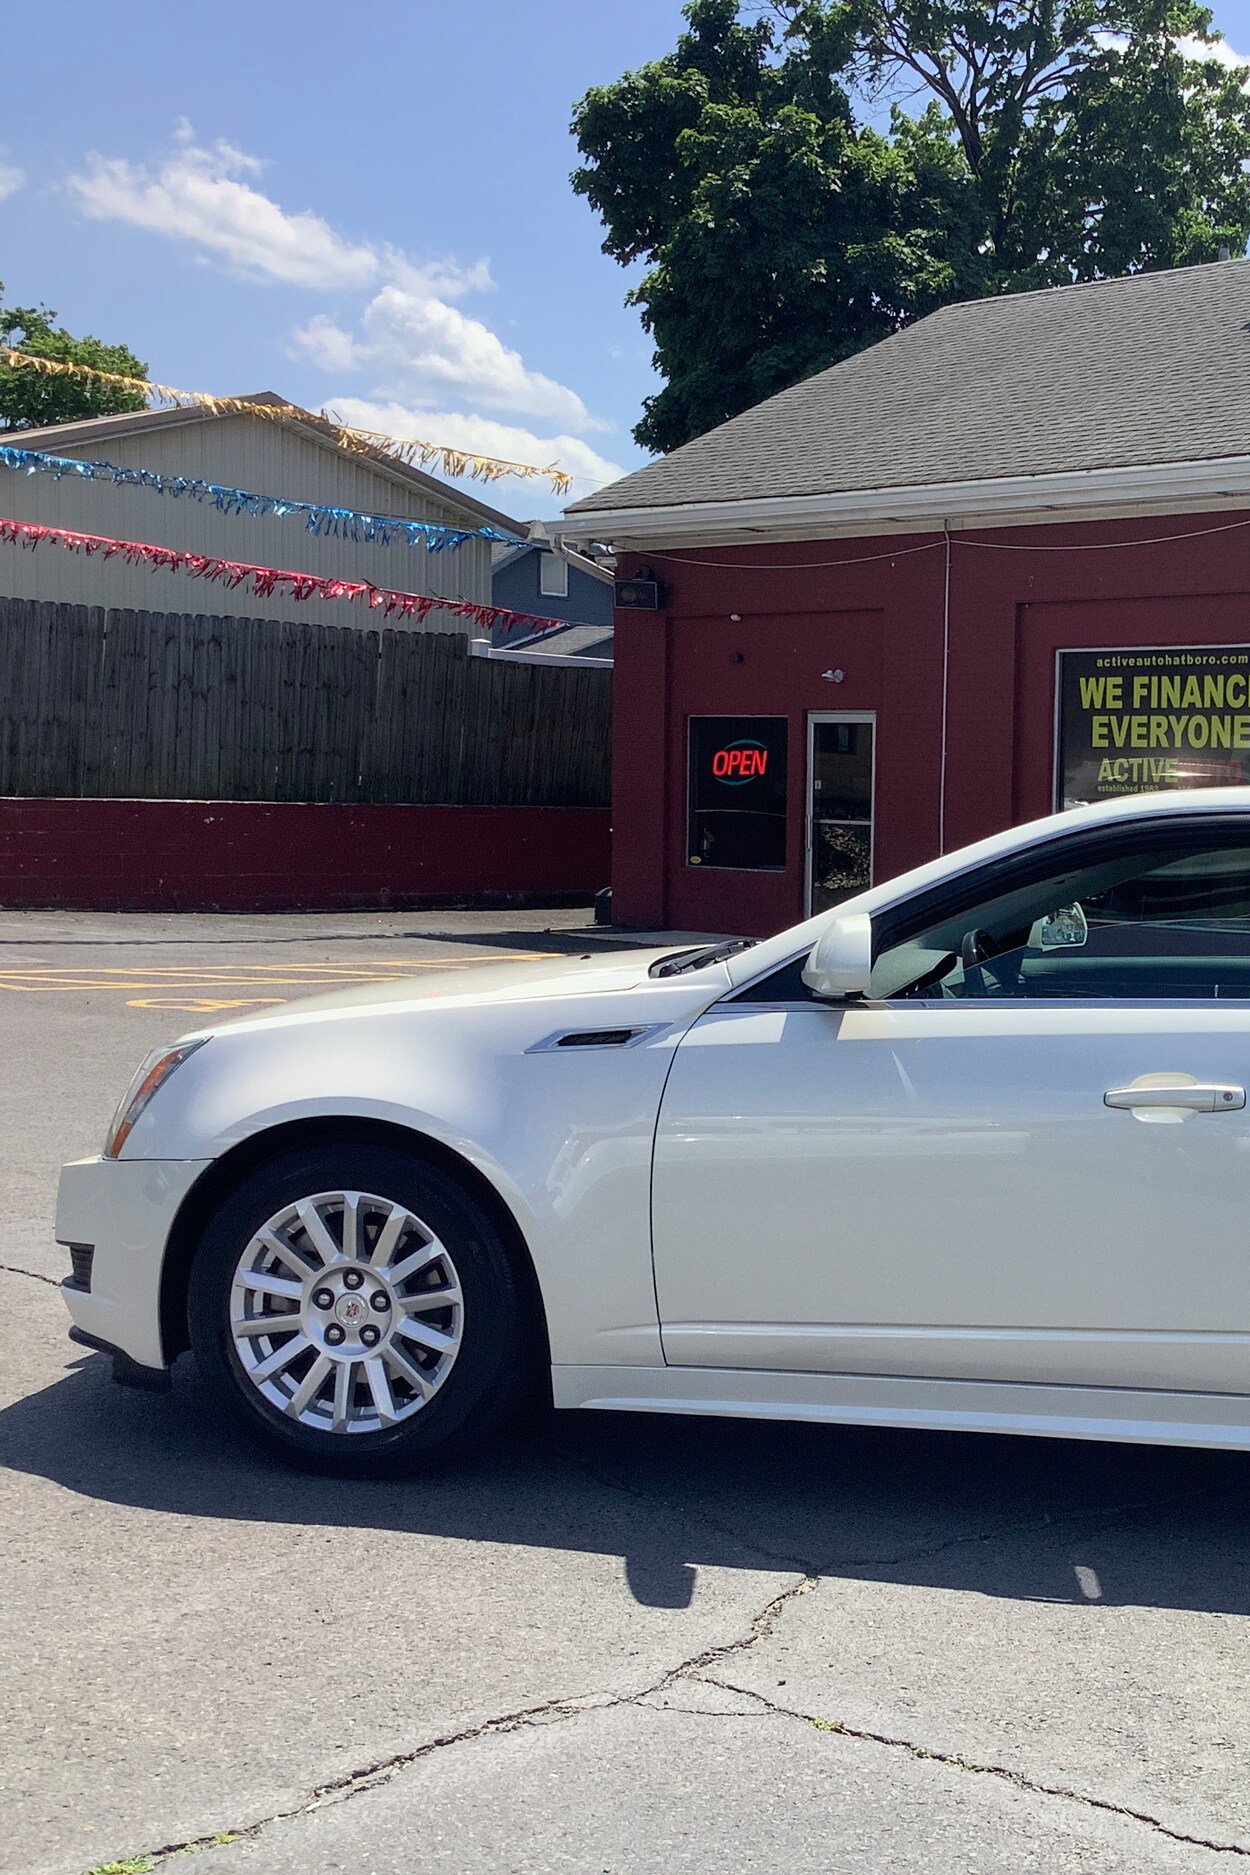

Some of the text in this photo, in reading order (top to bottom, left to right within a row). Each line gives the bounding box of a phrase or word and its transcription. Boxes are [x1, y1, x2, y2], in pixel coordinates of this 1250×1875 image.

[1096, 654, 1249, 667] activeautohatboro.com
[1079, 677, 1123, 709] WE
[712, 750, 768, 776] OPEN
[1097, 784, 1139, 793] established
